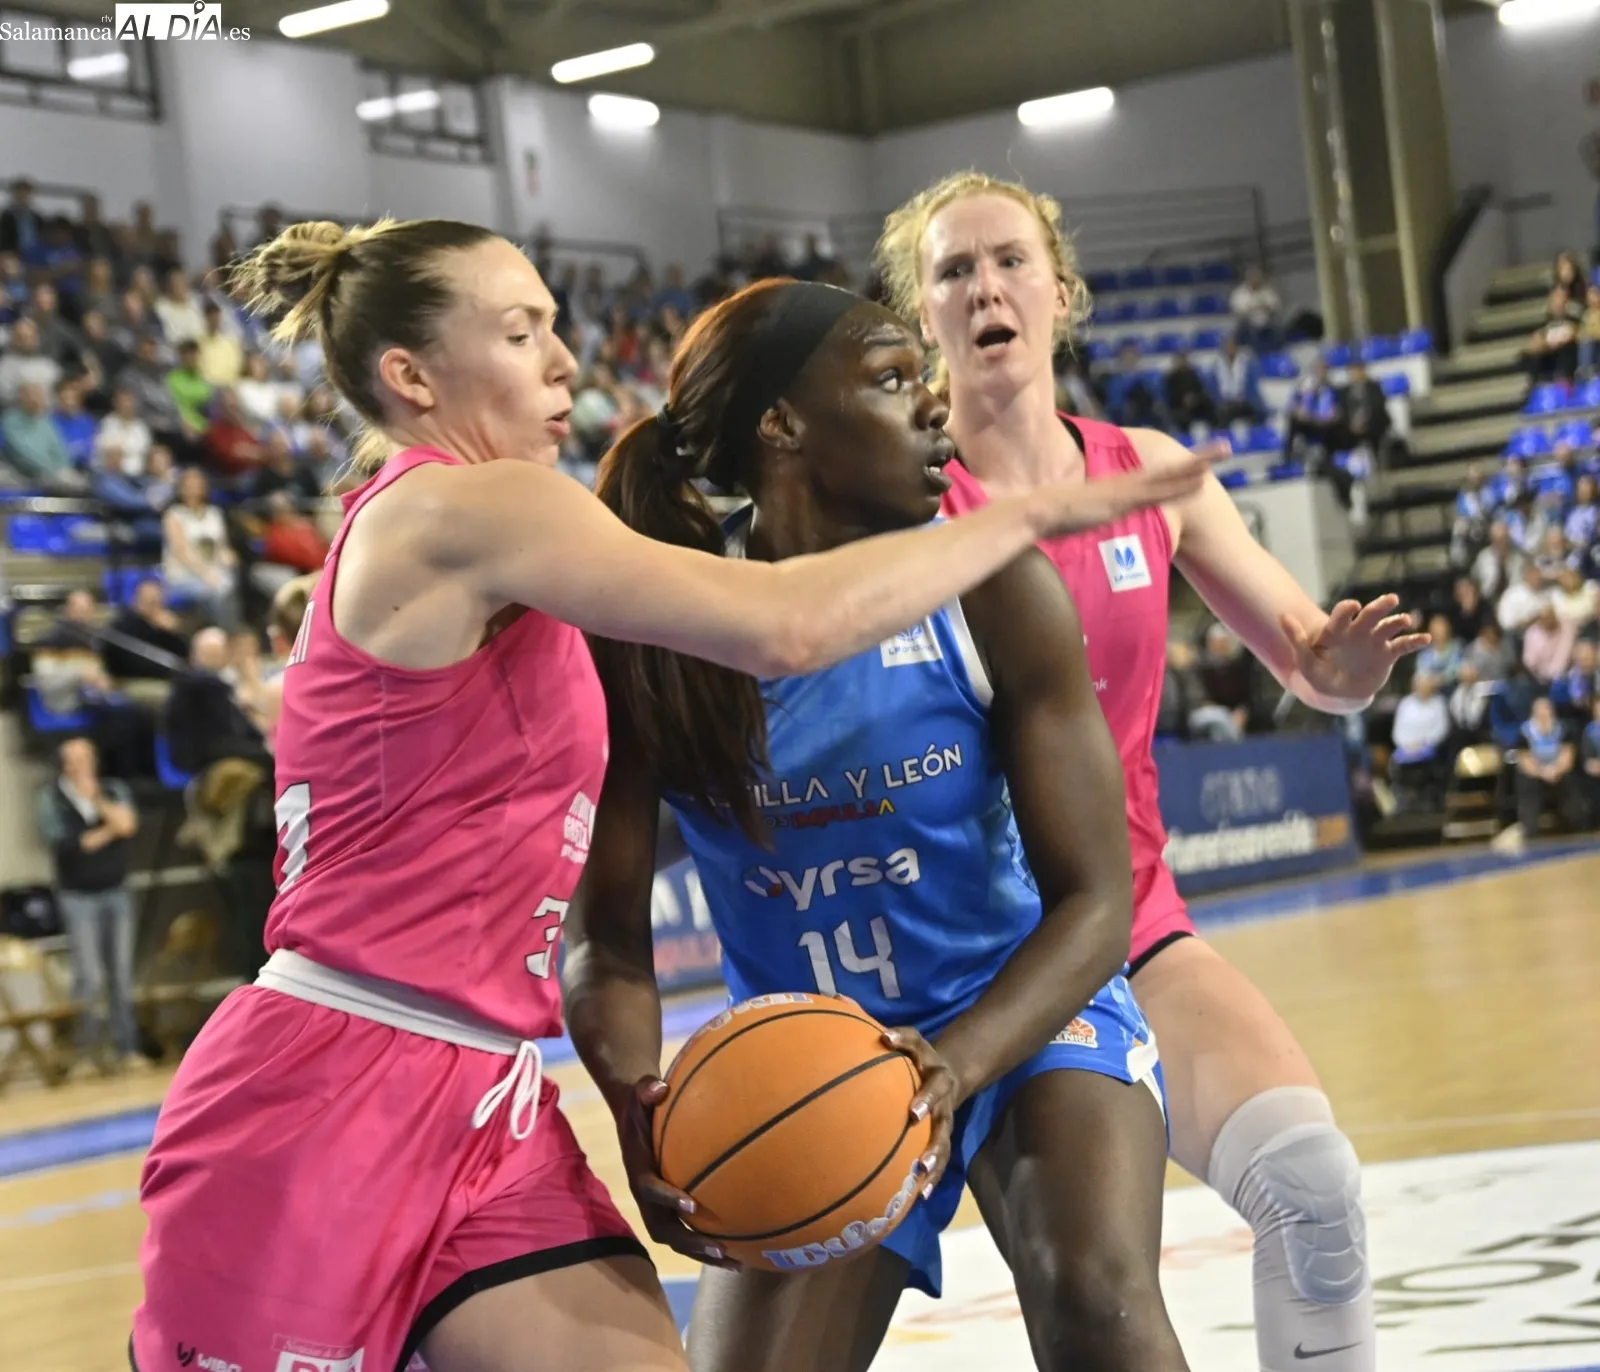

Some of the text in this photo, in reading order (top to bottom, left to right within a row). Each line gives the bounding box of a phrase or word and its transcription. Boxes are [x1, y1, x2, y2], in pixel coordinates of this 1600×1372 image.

[845, 768, 868, 799] Y
[883, 743, 962, 789] LEÓN
[797, 915, 902, 1000] 14
